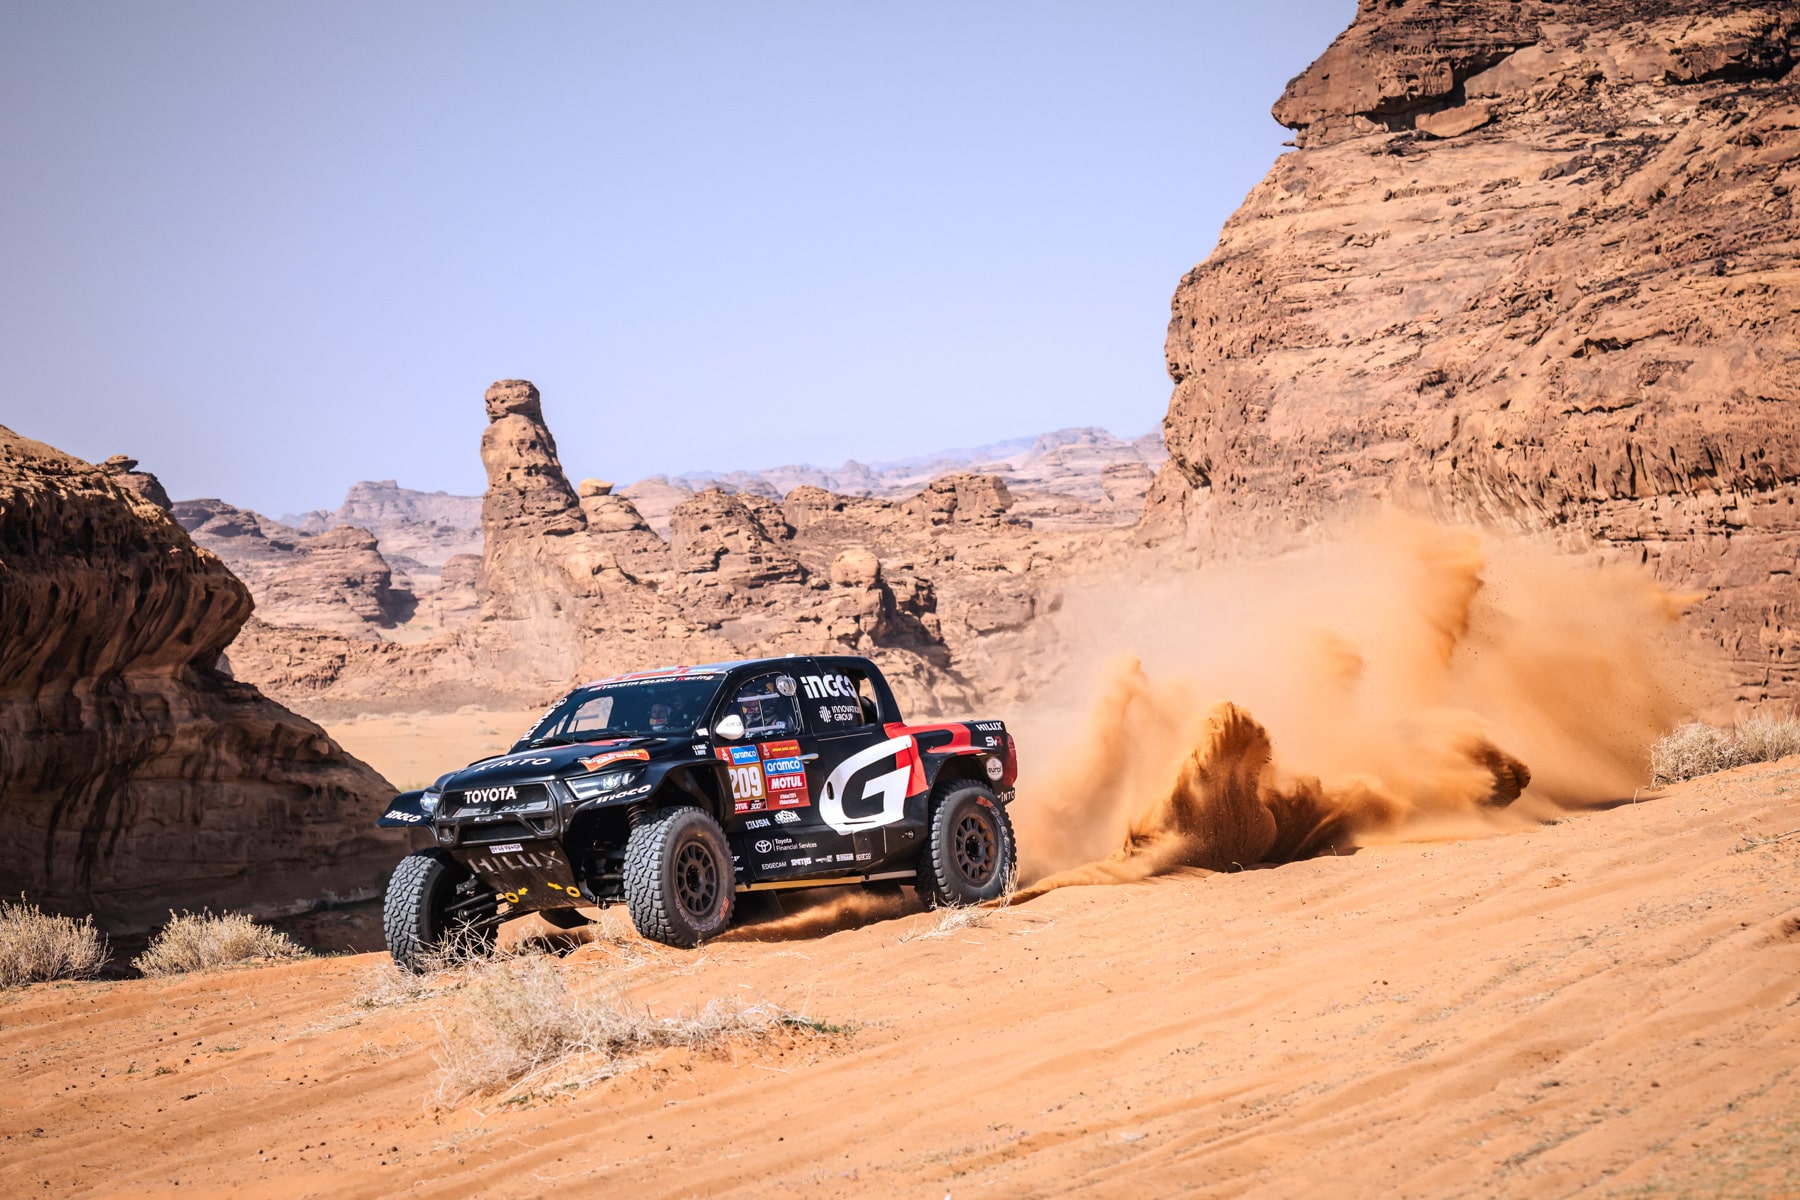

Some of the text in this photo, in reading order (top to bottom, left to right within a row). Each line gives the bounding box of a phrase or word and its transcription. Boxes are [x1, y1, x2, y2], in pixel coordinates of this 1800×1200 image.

[834, 713, 853, 721] GROUP
[976, 722, 1003, 732] HILUX
[733, 750, 757, 759] aramco
[767, 760, 800, 772] aramco
[728, 766, 762, 799] 209
[771, 776, 803, 790] MOTUL
[464, 786, 517, 804] TOYOTA
[467, 851, 565, 875] HILUX
[762, 861, 787, 870] EDGECAM
